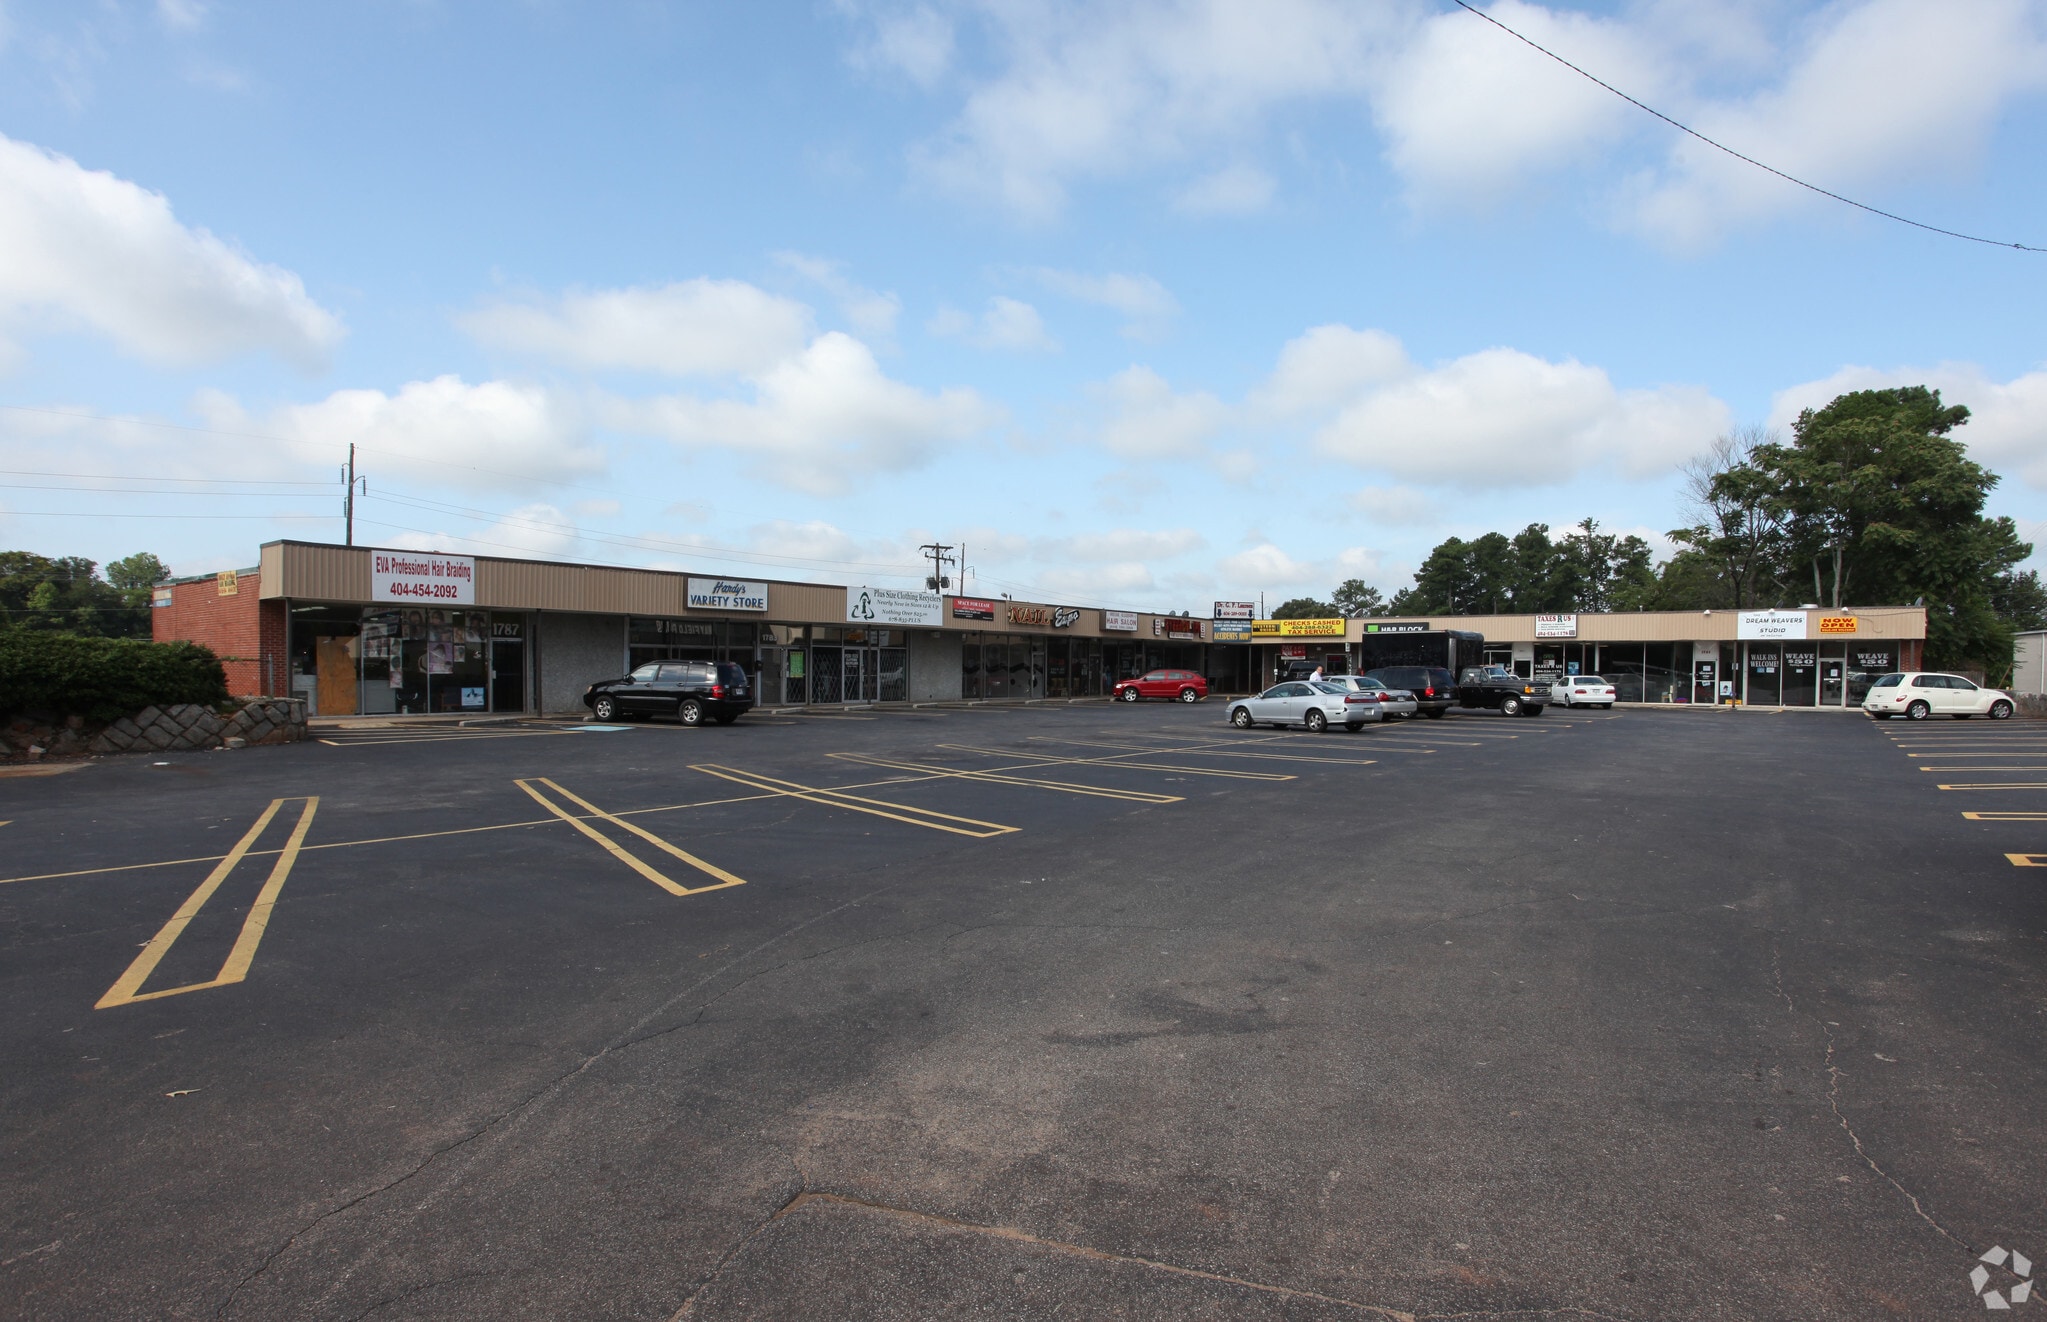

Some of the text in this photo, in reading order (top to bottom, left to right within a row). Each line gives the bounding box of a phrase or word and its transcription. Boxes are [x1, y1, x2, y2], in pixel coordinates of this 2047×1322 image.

[376, 556, 471, 582] EVA Professional Hair Braiding
[390, 582, 457, 598] 404-454-2092
[712, 582, 746, 596] Hardy's
[874, 589, 941, 602] Plus Size Clothing Recyclers
[690, 595, 763, 608] VARIETY STORE
[1008, 606, 1080, 628] NAIL Expo
[493, 622, 519, 635] 1787
